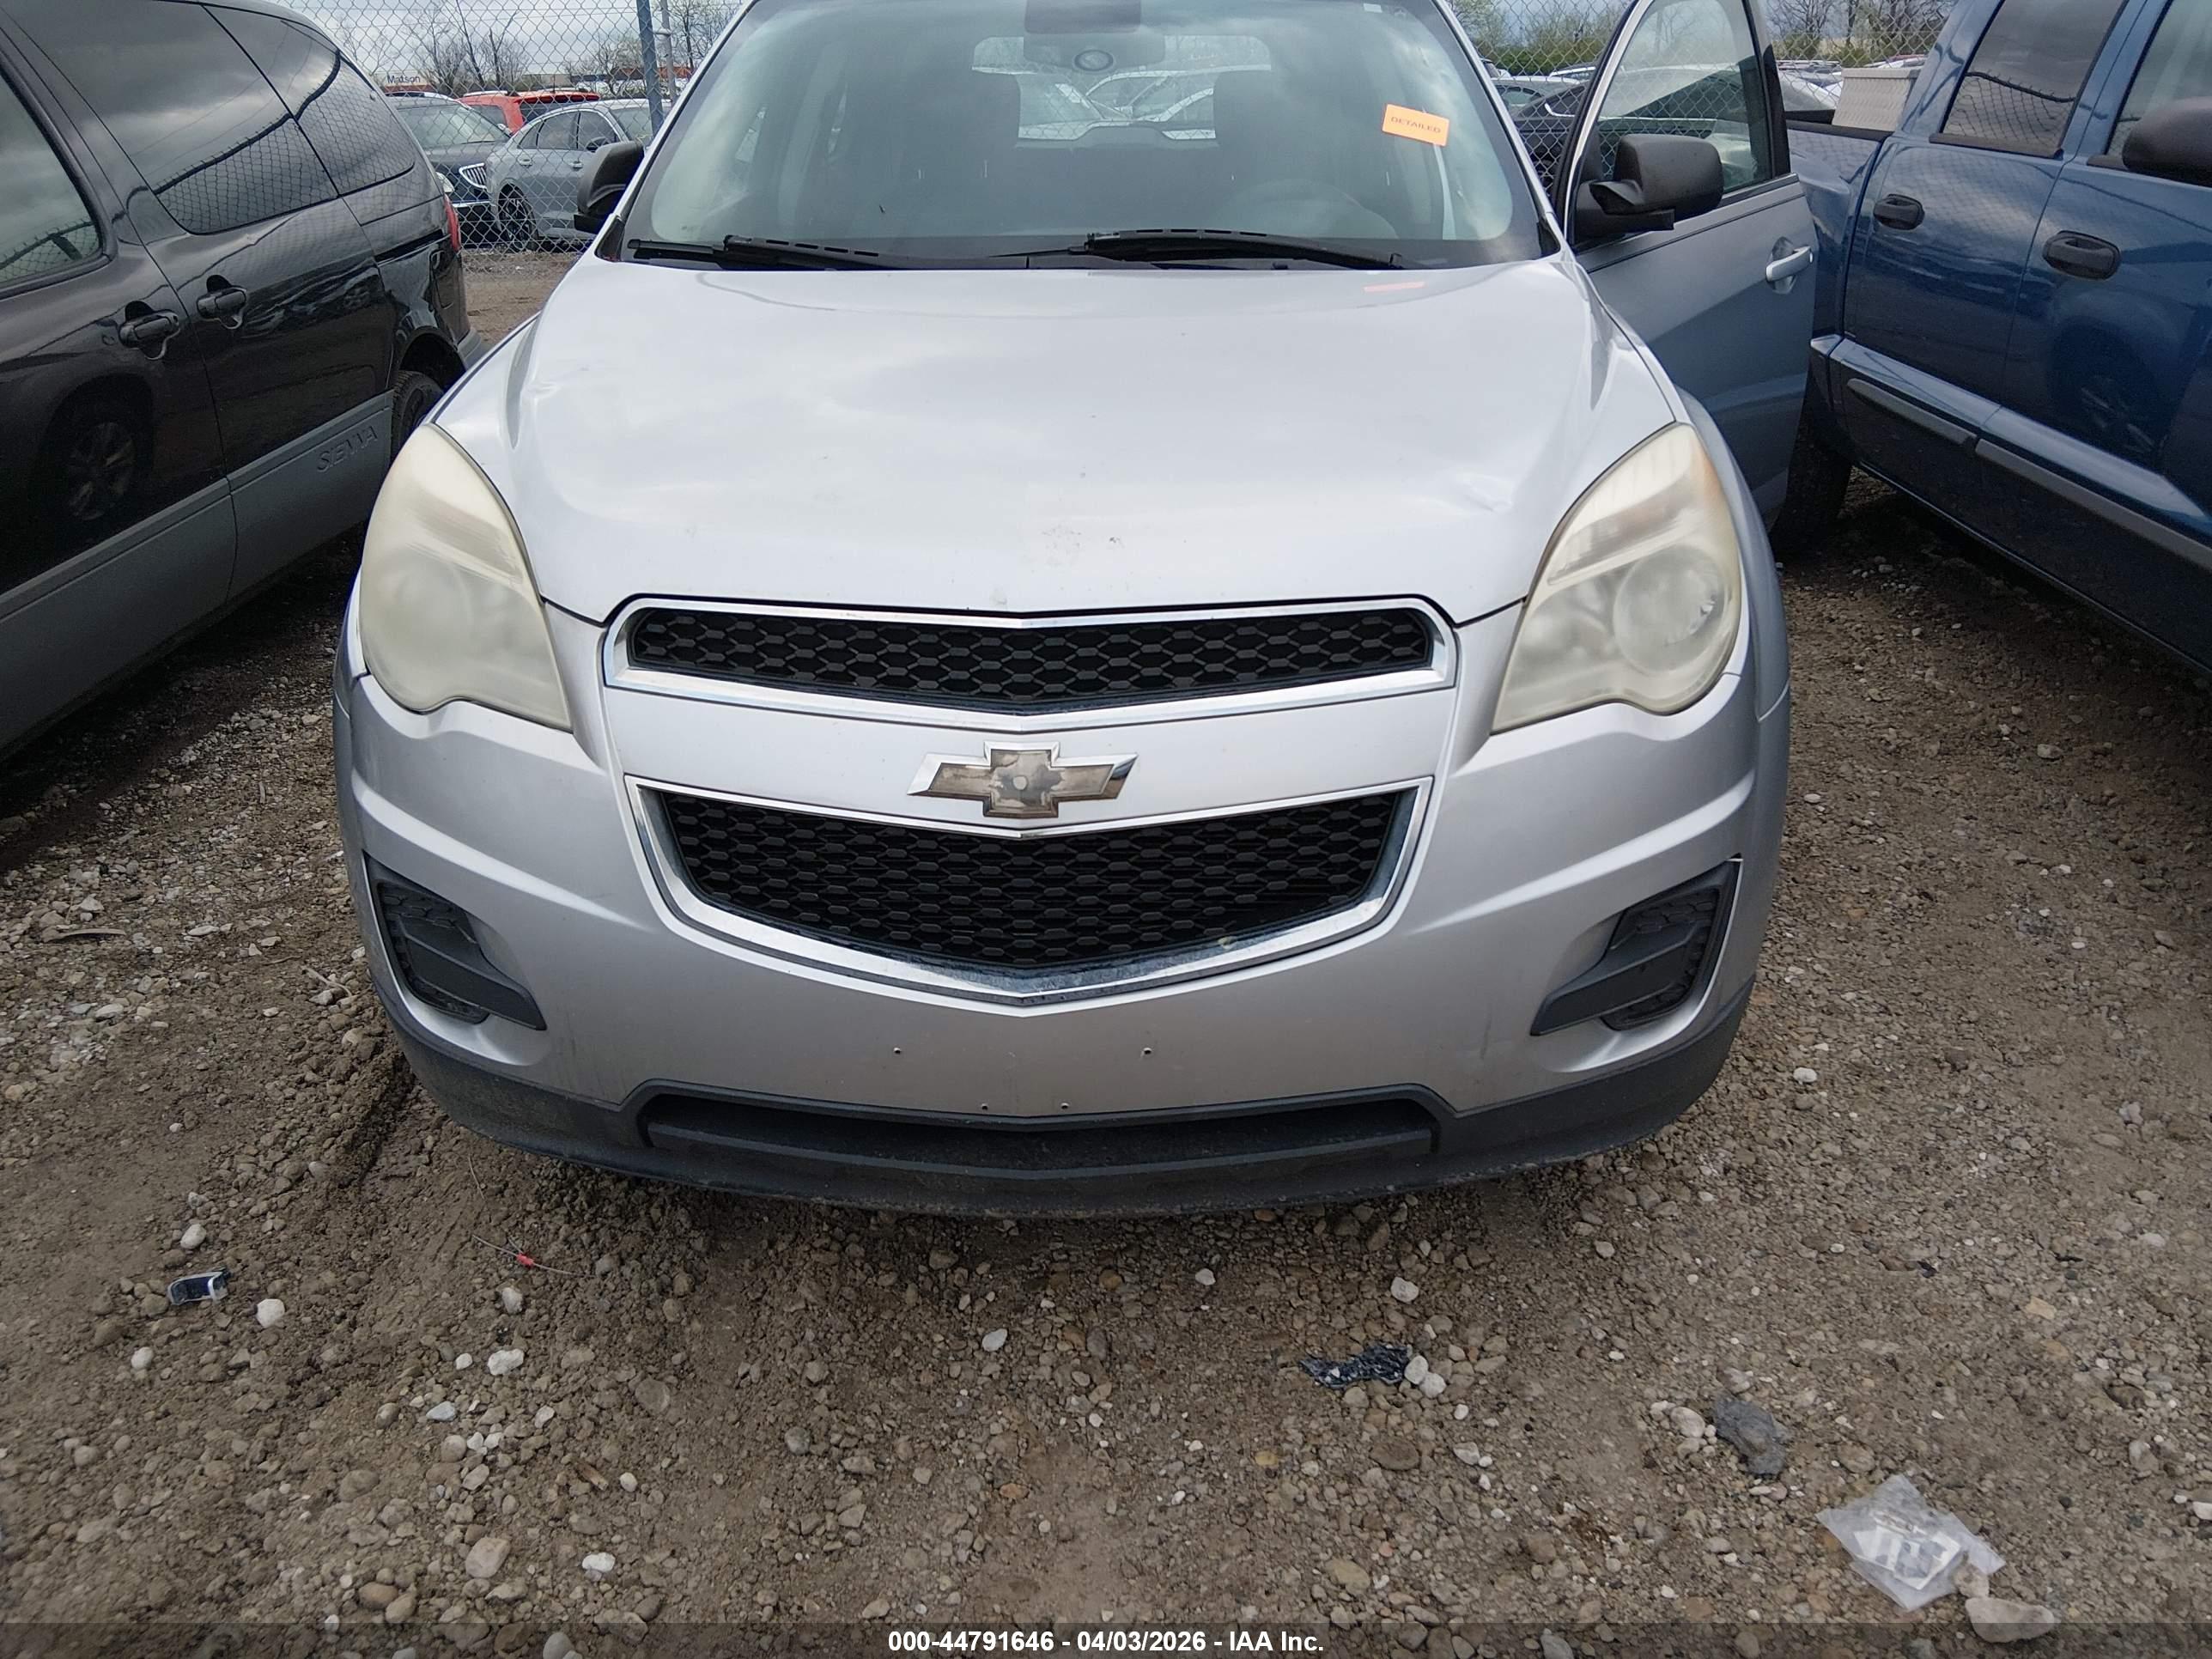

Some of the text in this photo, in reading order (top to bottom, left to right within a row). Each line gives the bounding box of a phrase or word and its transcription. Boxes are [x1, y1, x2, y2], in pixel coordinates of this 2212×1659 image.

[387, 75, 421, 83] Matson
[1390, 116, 1442, 134] DETAILED
[317, 425, 378, 472] SIENNA
